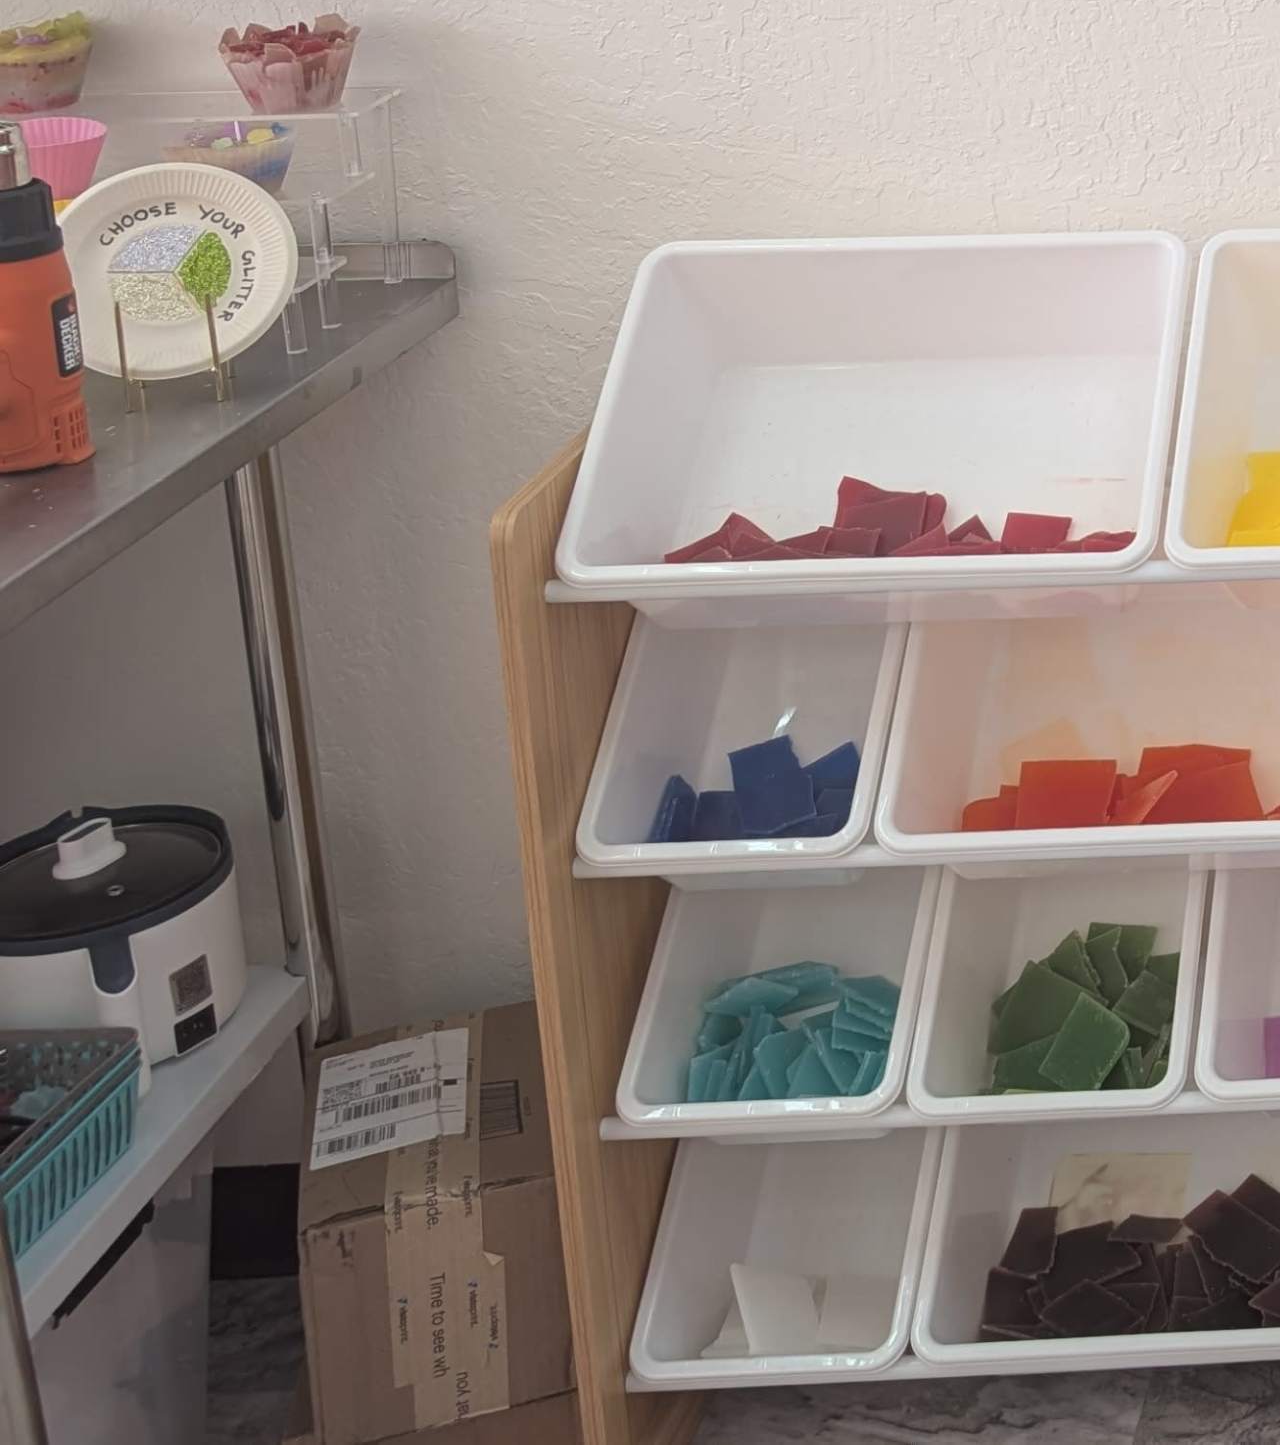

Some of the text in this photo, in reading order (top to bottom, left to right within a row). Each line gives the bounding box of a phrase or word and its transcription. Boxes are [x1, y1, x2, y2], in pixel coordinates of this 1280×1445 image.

[99, 202, 257, 323] CHOOSE YOUR GLITTER
[425, 1186, 442, 1230] made.
[430, 1271, 446, 1308] Time
[431, 1309, 446, 1326] to
[432, 1329, 446, 1353] see
[455, 1371, 472, 1398] you
